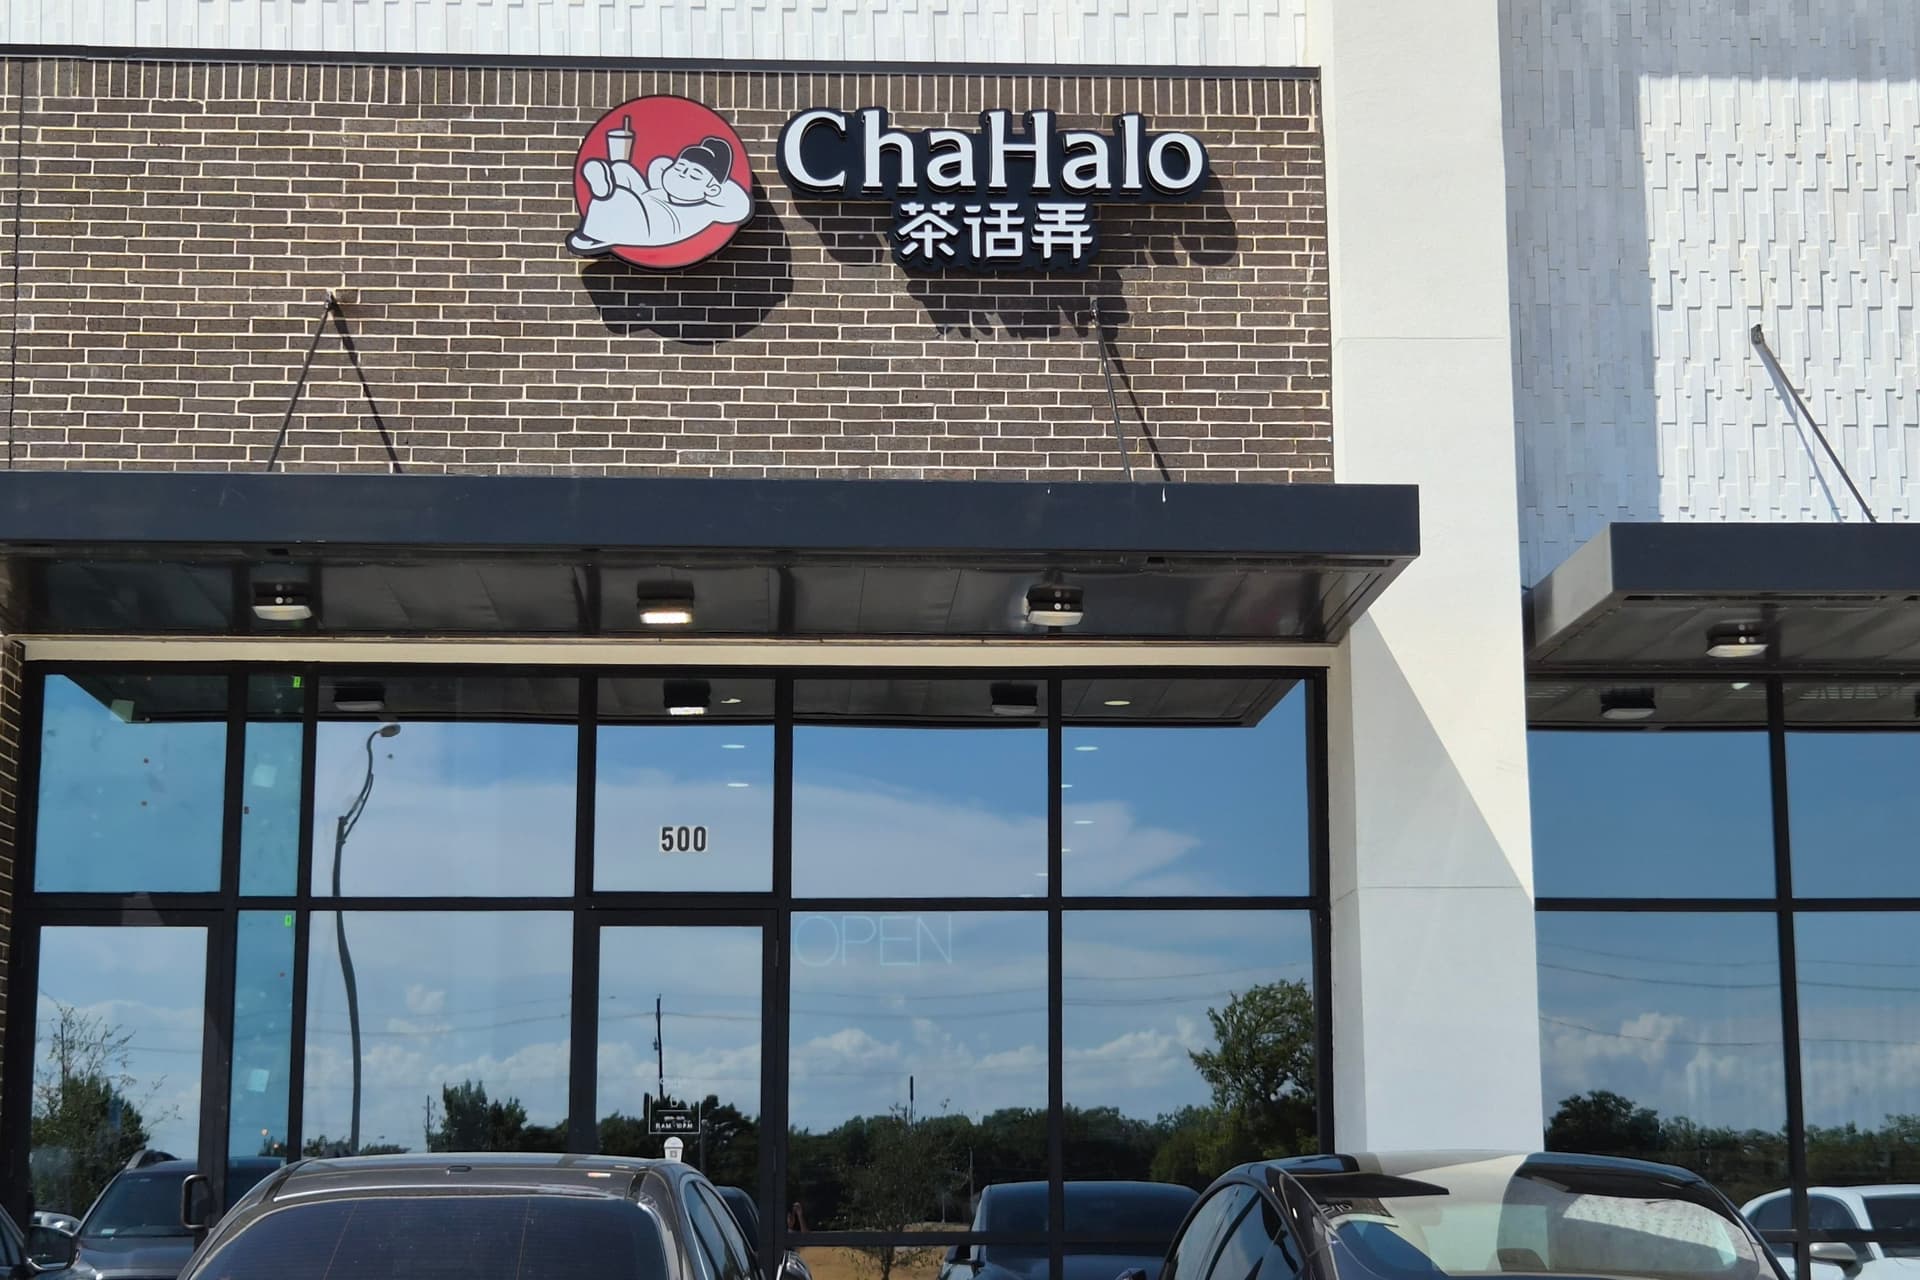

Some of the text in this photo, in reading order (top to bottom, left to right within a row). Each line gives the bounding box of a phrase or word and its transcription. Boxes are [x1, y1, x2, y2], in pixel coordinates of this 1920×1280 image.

[784, 109, 1205, 192] ChaHalo
[897, 202, 1094, 260] 茶话弄
[661, 826, 707, 852] 500
[794, 914, 953, 968] OPEN
